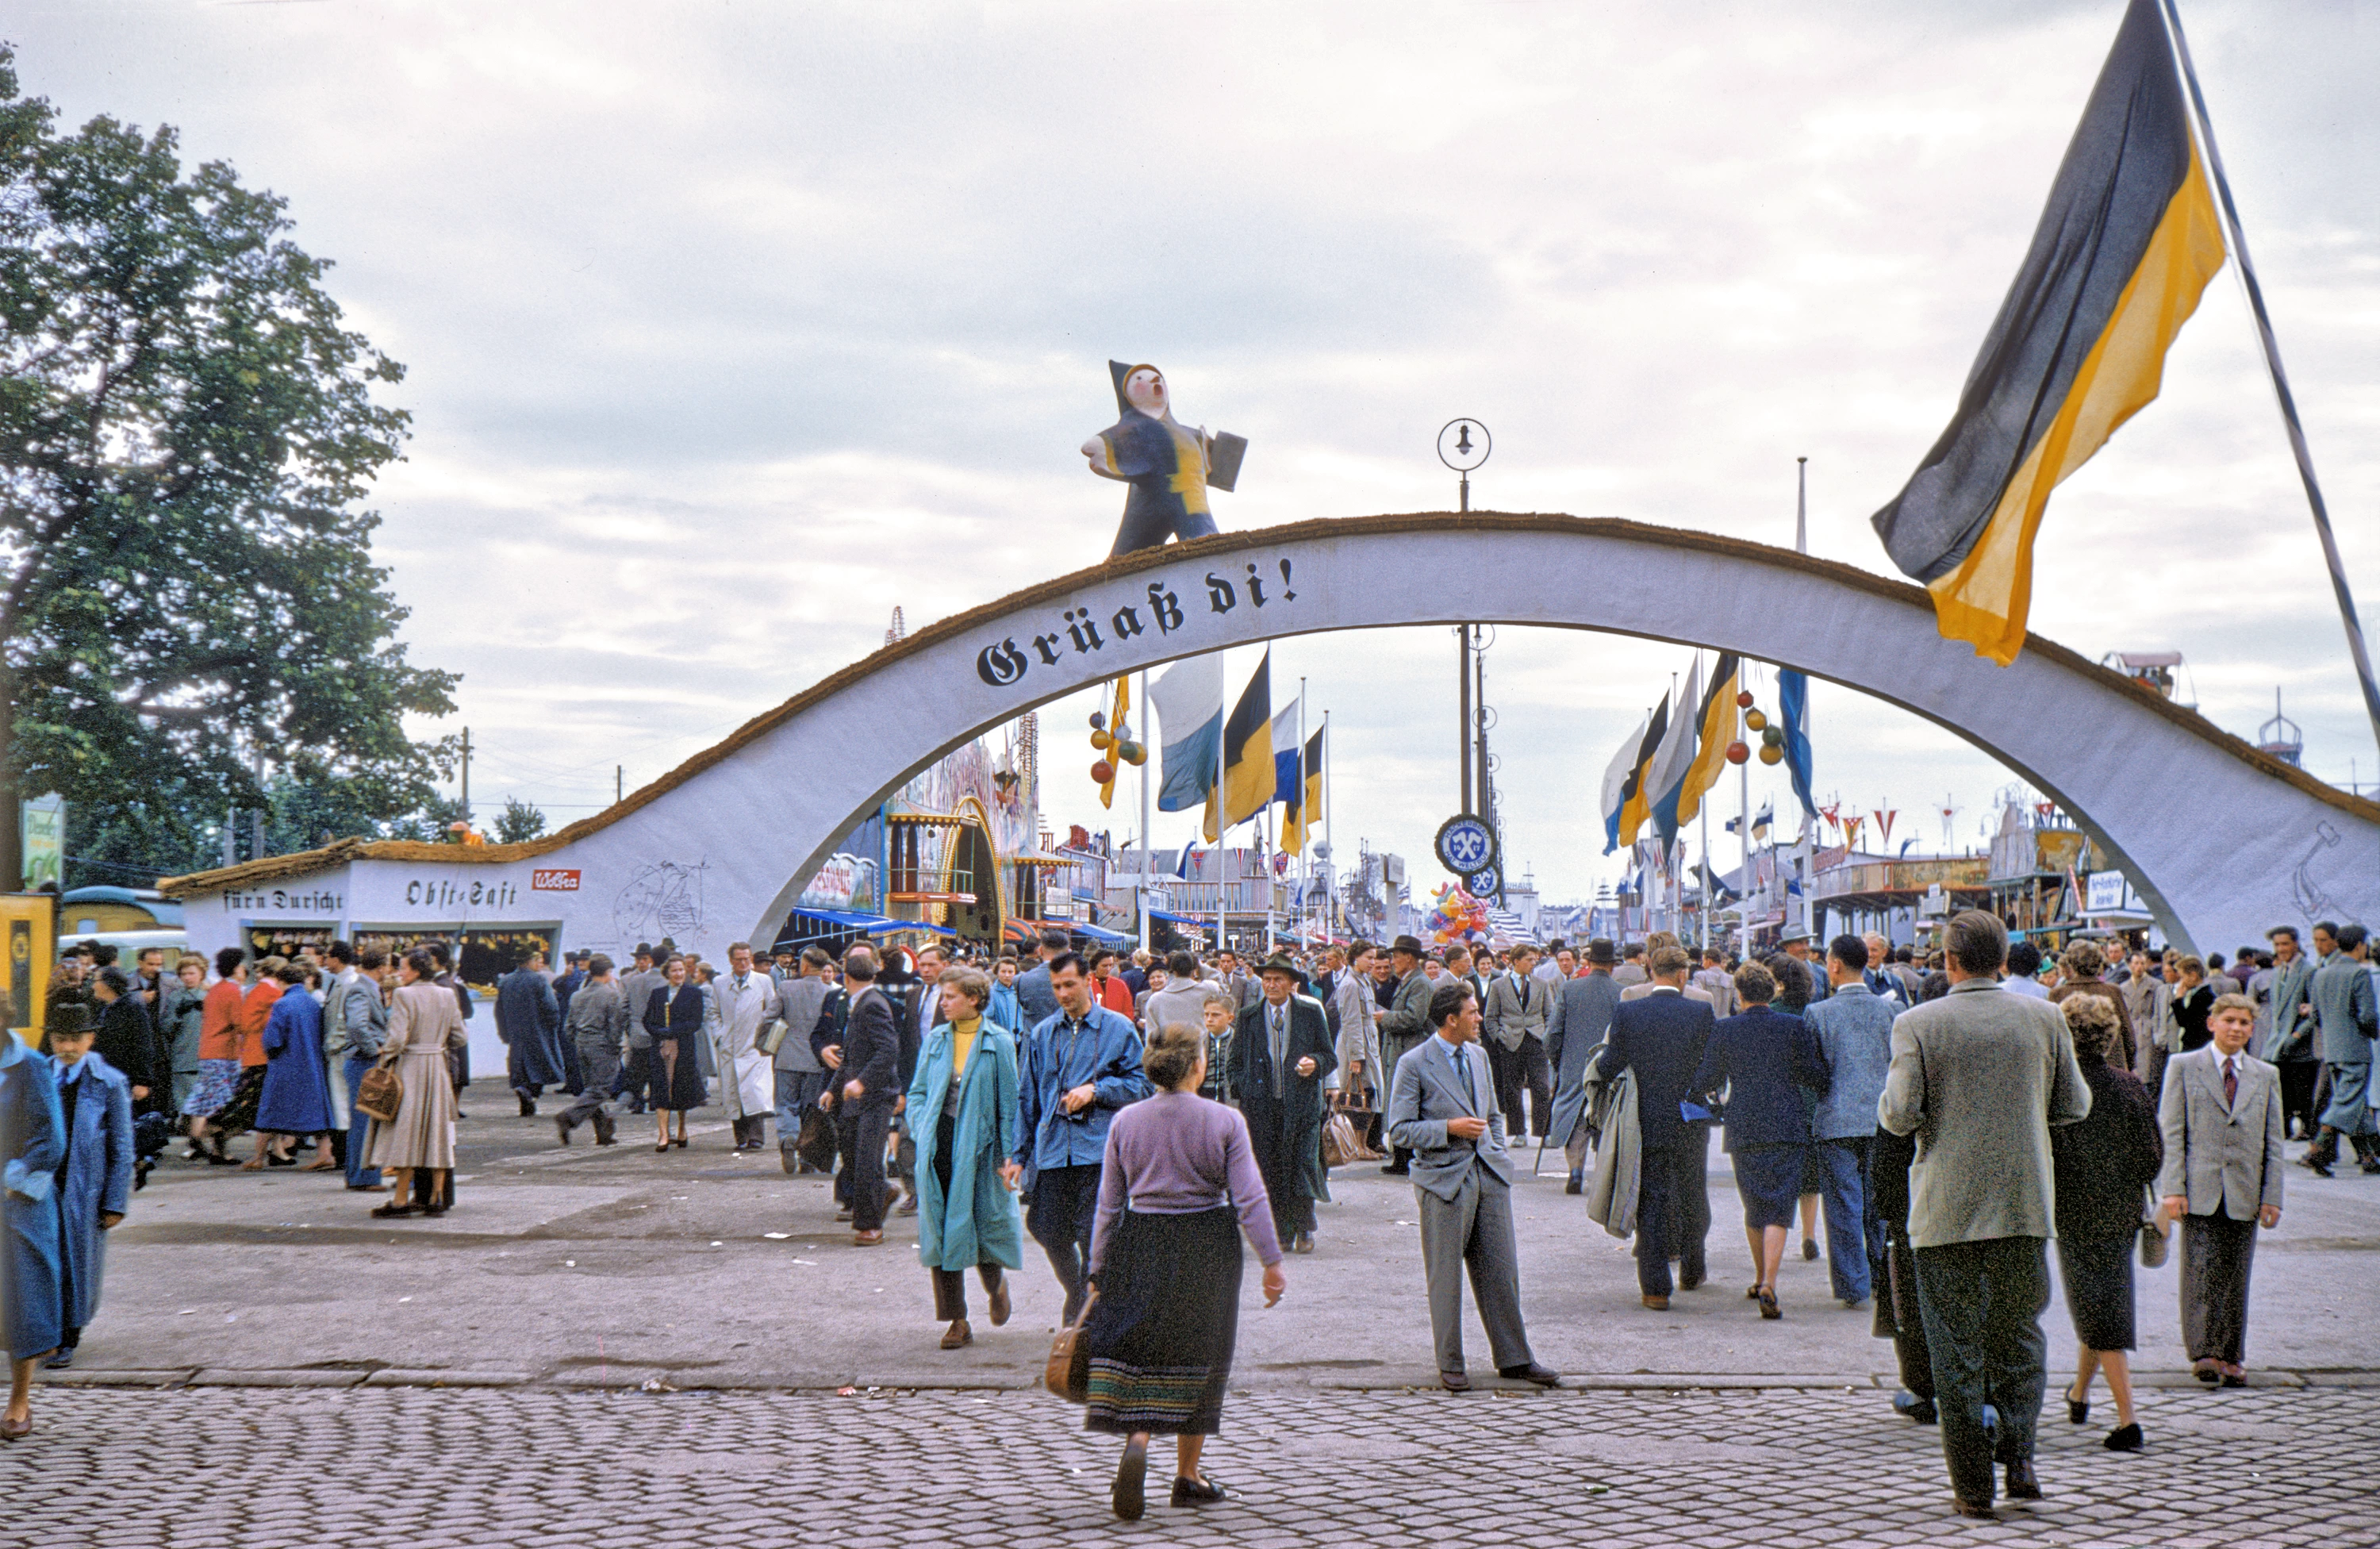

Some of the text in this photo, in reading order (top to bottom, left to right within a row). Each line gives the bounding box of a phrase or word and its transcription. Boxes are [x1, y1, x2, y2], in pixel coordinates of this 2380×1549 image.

[977, 558, 1298, 687] Grüaß di!
[1458, 851, 1489, 868] WELTRUF
[272, 890, 344, 913] Durscht
